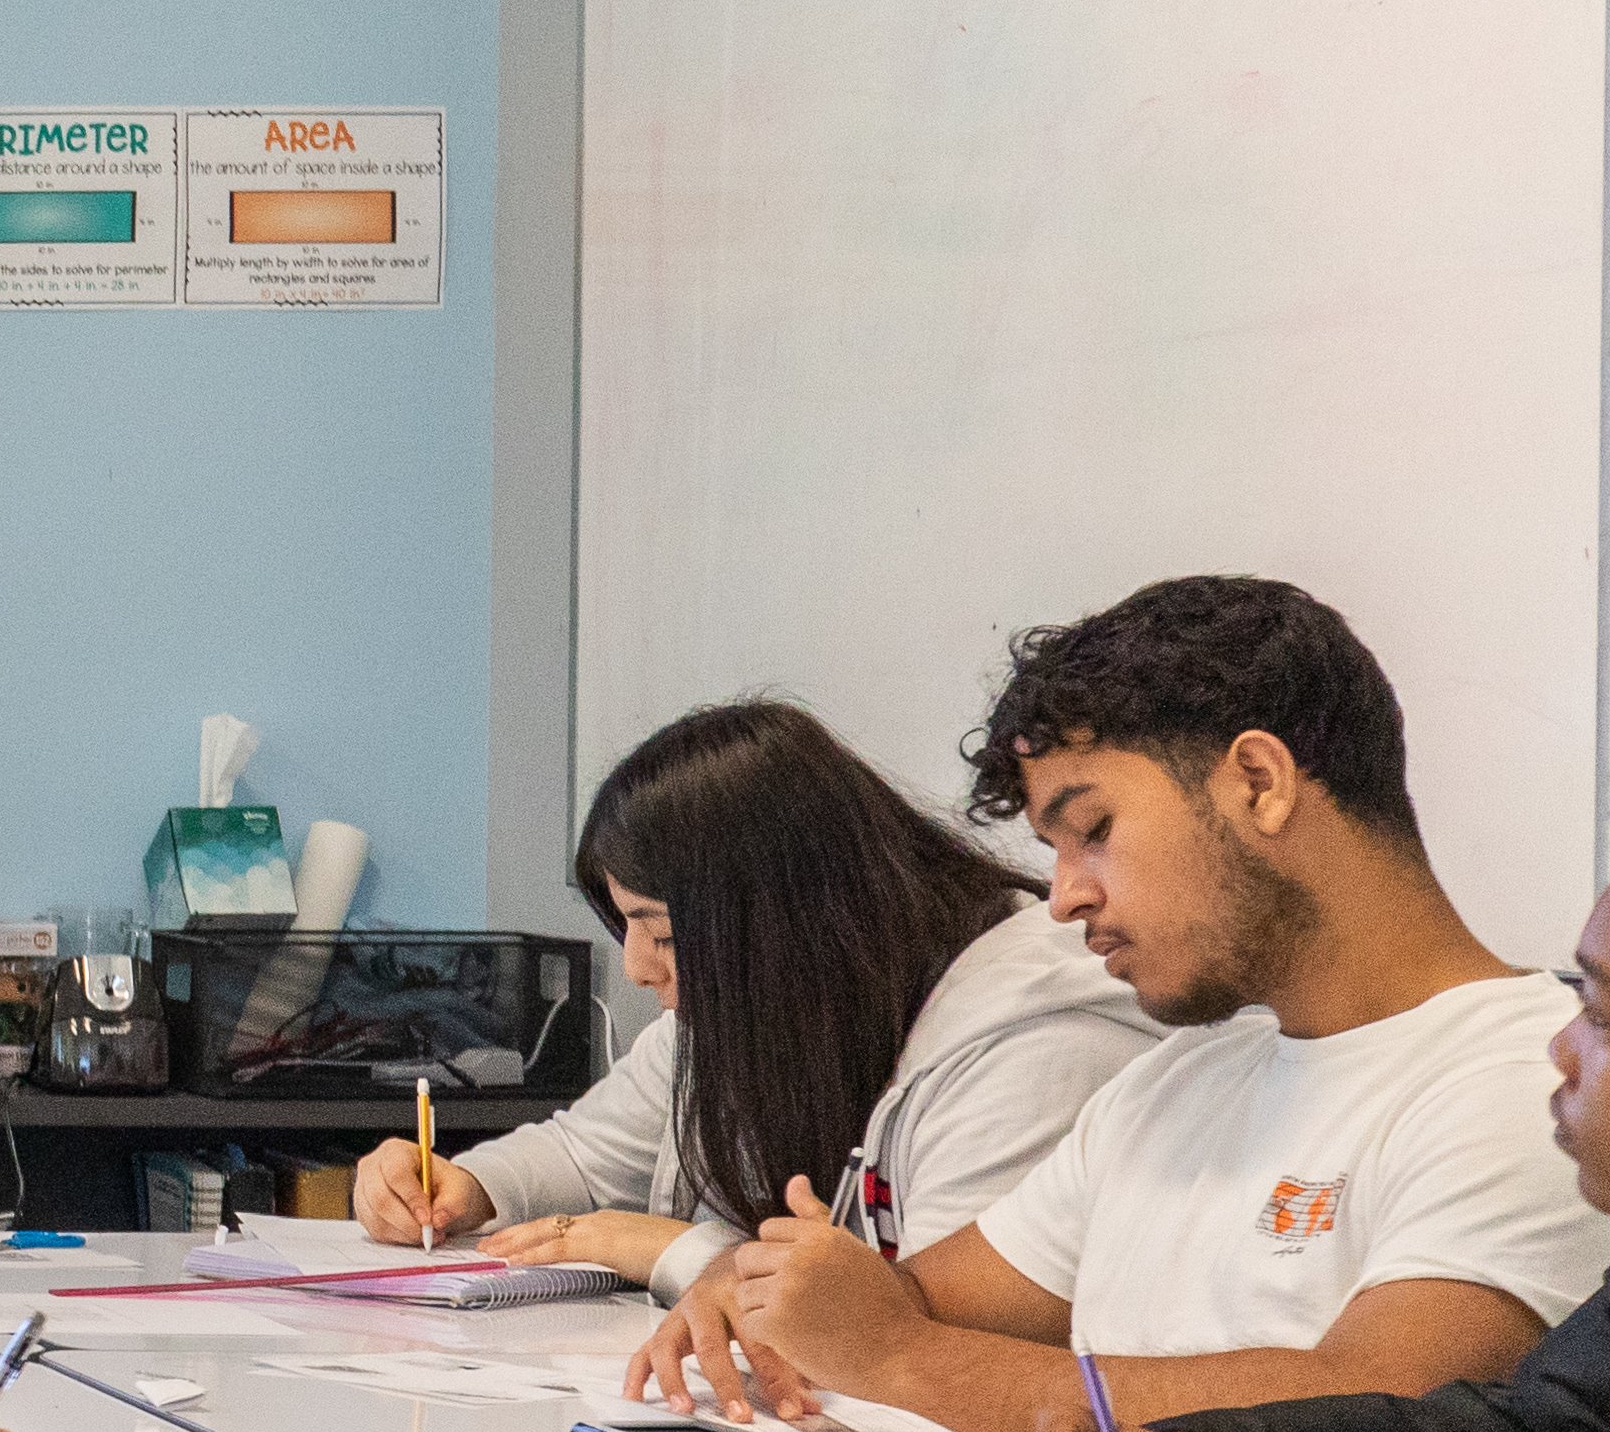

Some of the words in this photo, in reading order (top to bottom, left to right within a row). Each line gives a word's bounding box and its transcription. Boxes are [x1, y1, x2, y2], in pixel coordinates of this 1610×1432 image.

[55, 157, 107, 176] around
[108, 162, 119, 175] a
[121, 159, 163, 179] shape
[189, 159, 213, 176] the
[215, 160, 269, 176] amount
[272, 157, 292, 176] of
[295, 162, 337, 180] space
[339, 158, 380, 176] inside
[382, 163, 393, 176] a
[395, 159, 437, 179] shape
[0, 264, 18, 276] the
[20, 263, 49, 276] sides
[51, 263, 64, 276] to
[64, 263, 94, 276] solve
[95, 263, 112, 276] for
[114, 263, 169, 277] perimeter
